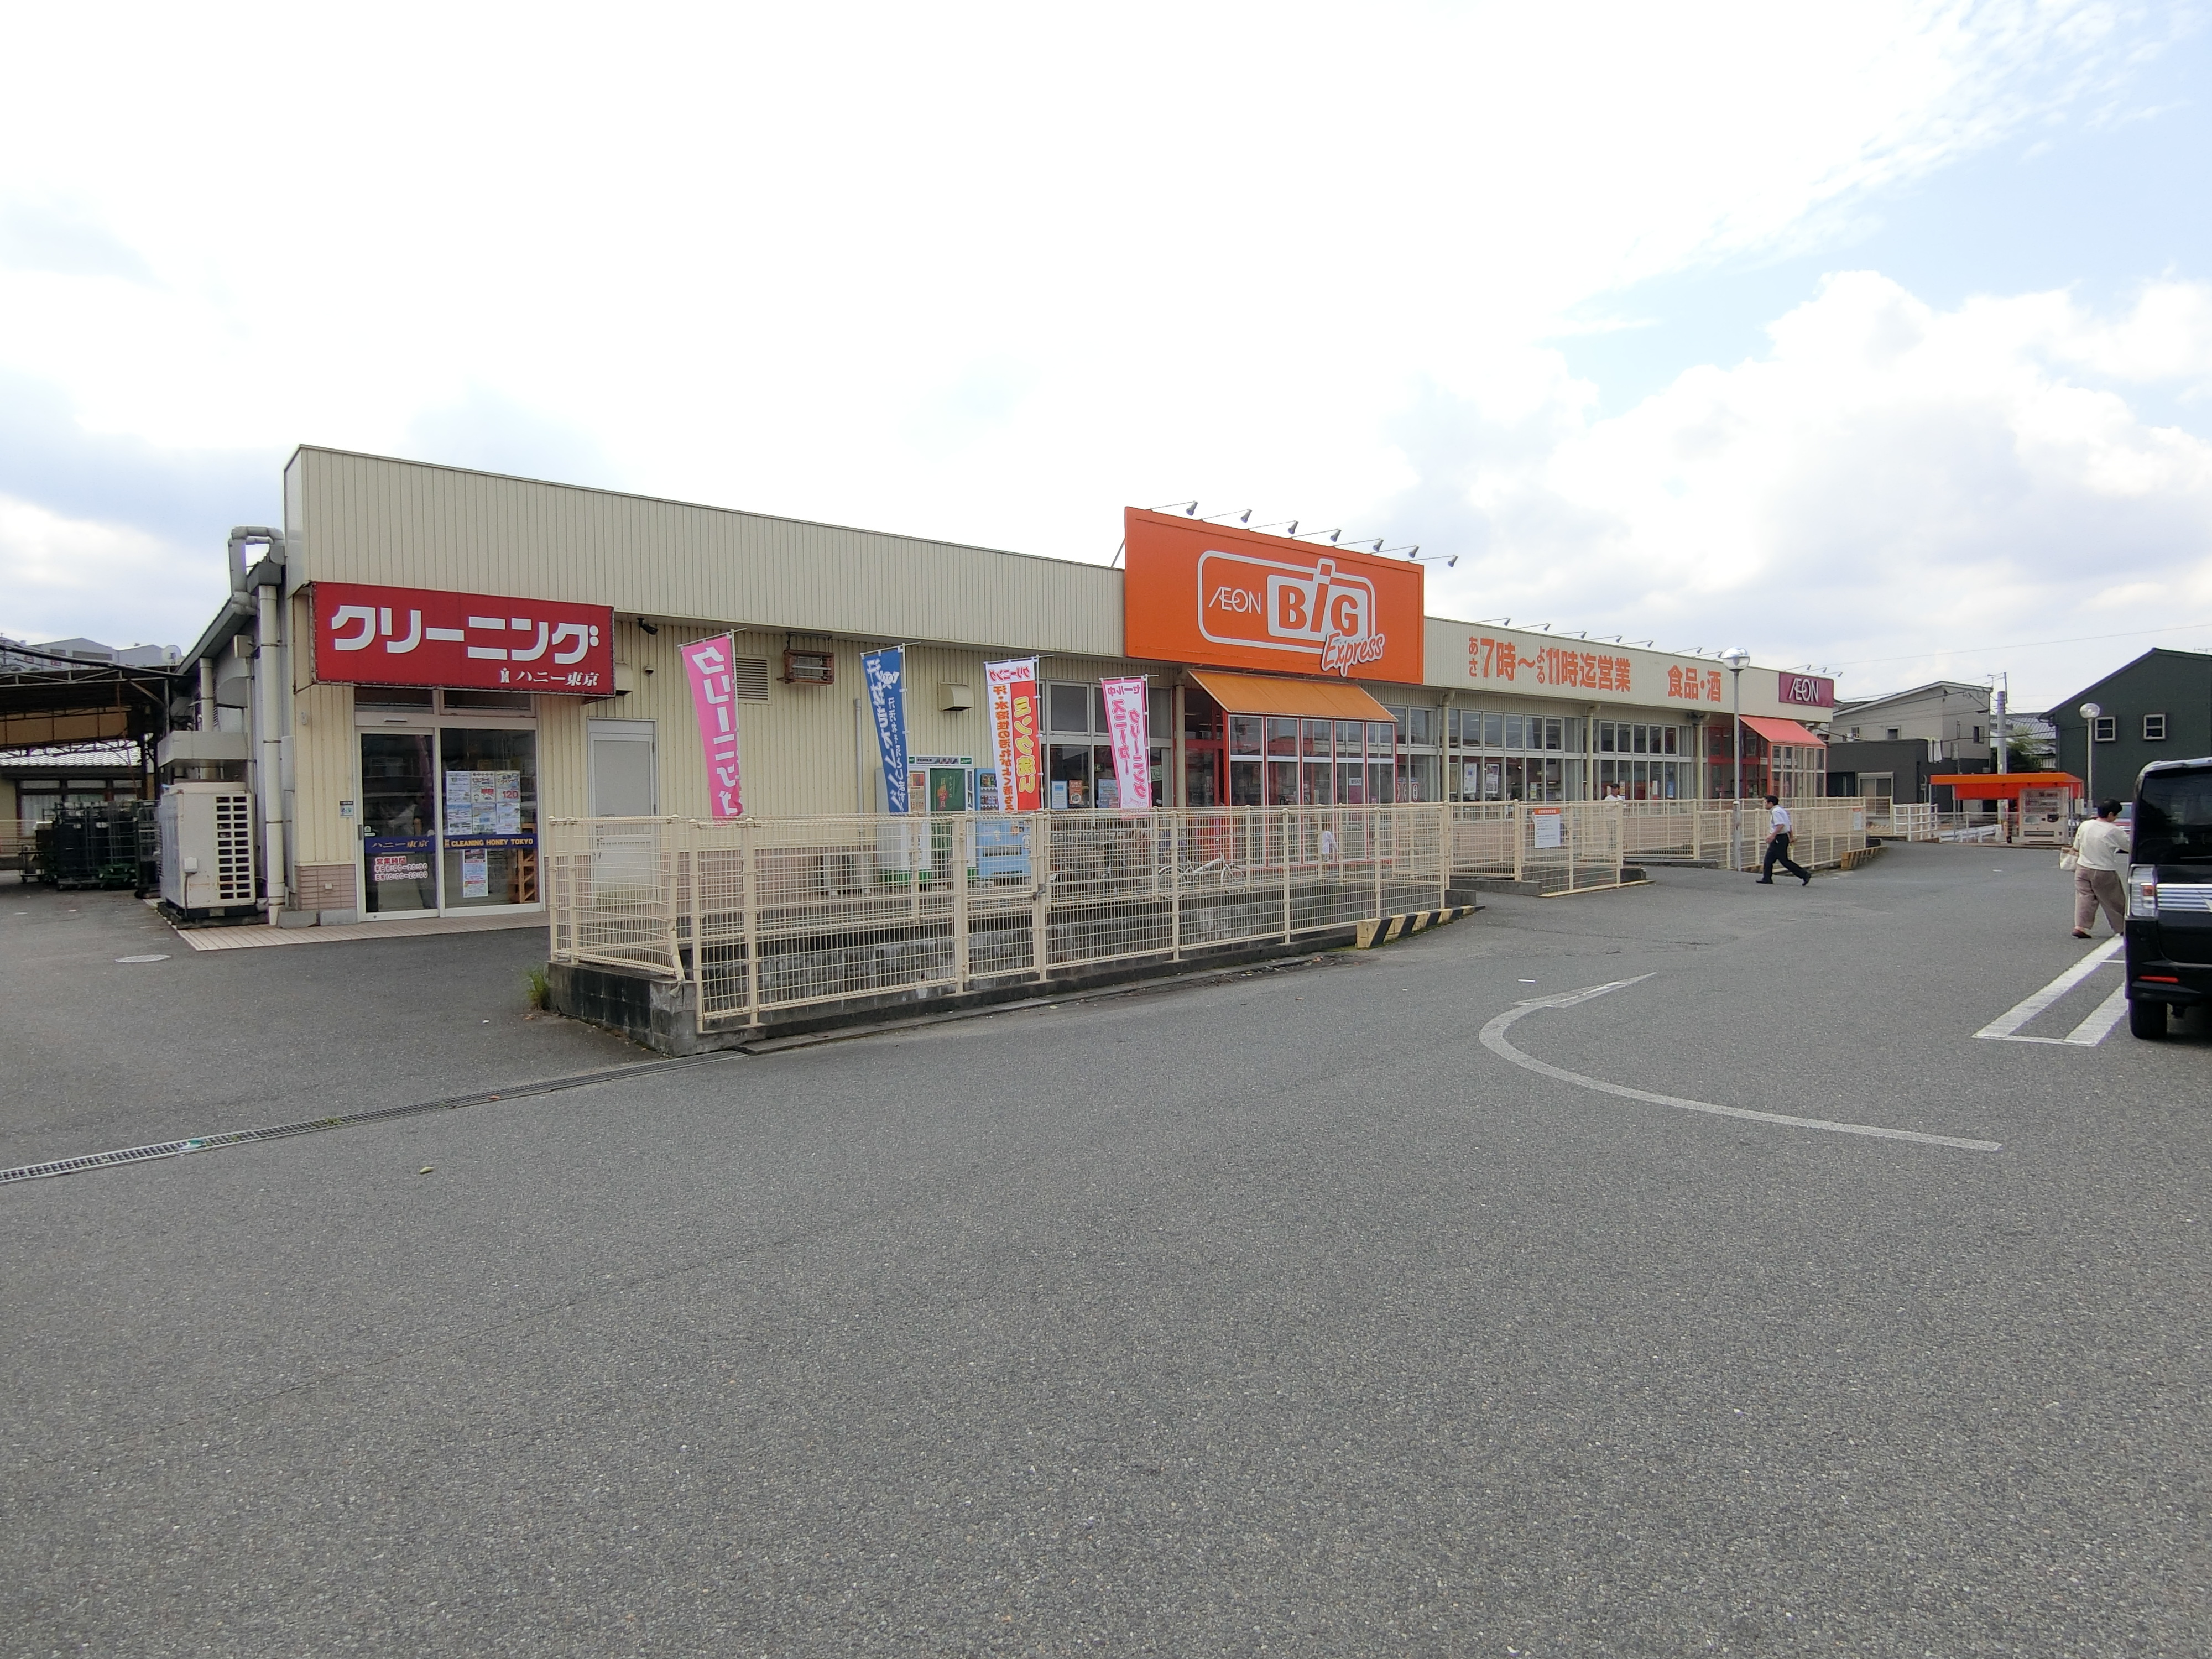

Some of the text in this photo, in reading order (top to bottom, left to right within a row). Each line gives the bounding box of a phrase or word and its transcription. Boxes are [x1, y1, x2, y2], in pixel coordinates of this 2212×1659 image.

[331, 605, 600, 665] クリーニング
[1322, 630, 1385, 676] Express
[515, 671, 600, 686] ハニー東京
[372, 840, 430, 848] ハニー東京
